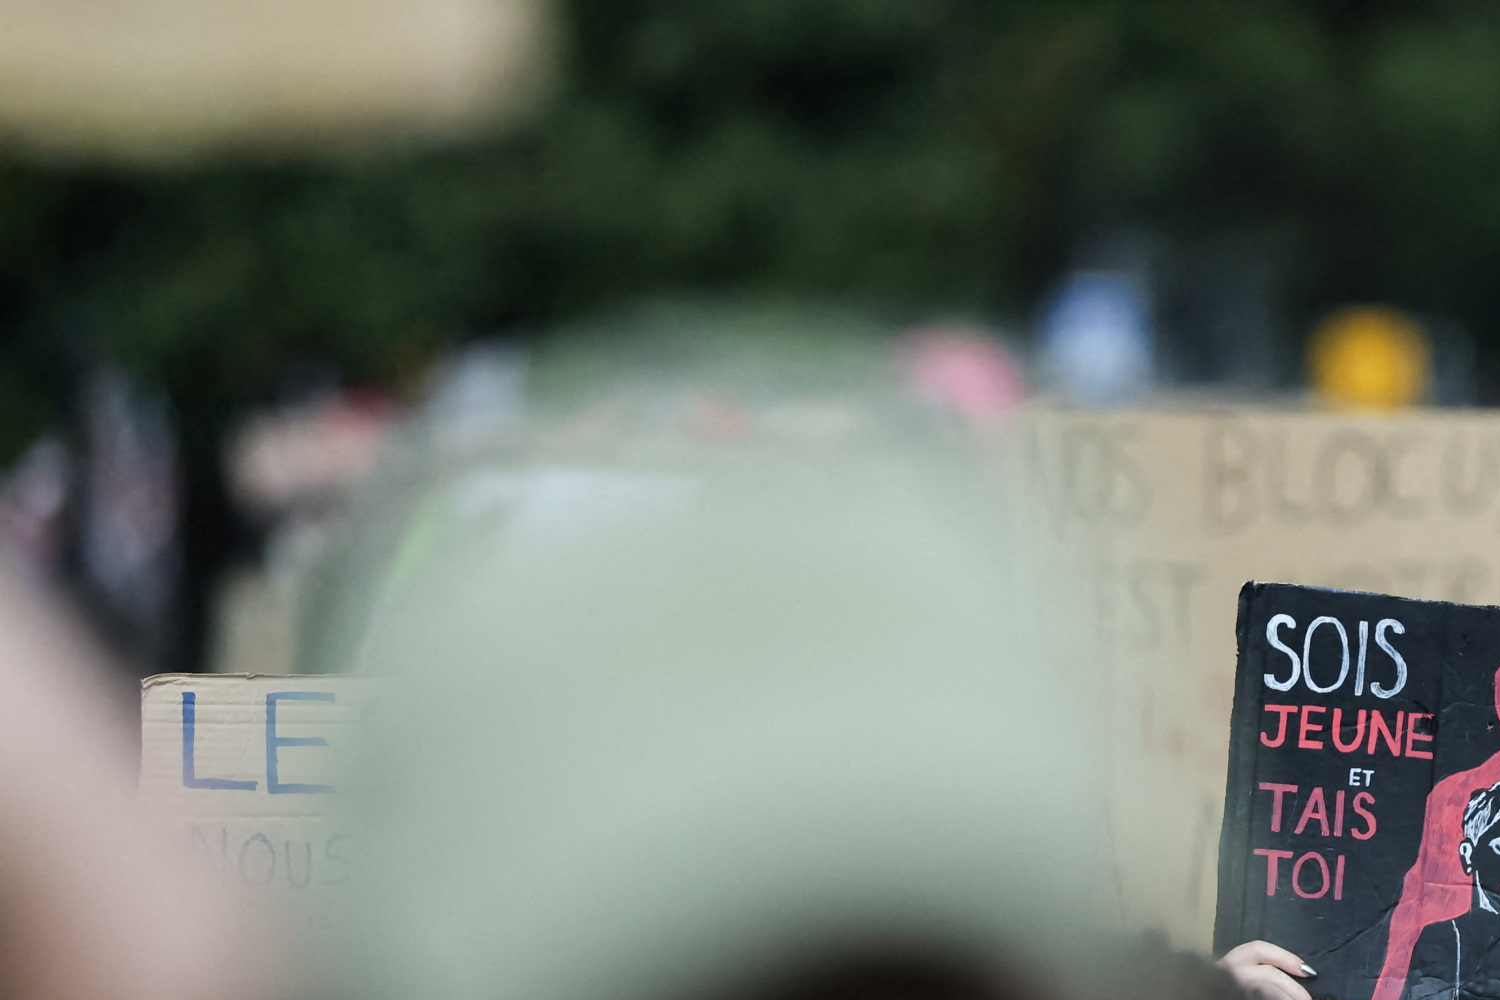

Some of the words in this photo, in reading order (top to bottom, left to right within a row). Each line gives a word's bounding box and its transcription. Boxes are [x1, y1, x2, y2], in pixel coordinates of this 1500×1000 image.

[1264, 613, 1408, 699] SOIS
[1259, 704, 1434, 760] JEUNE
[1349, 768, 1375, 787] ET
[1258, 782, 1377, 841] TAIS
[1253, 848, 1345, 901] TOI
